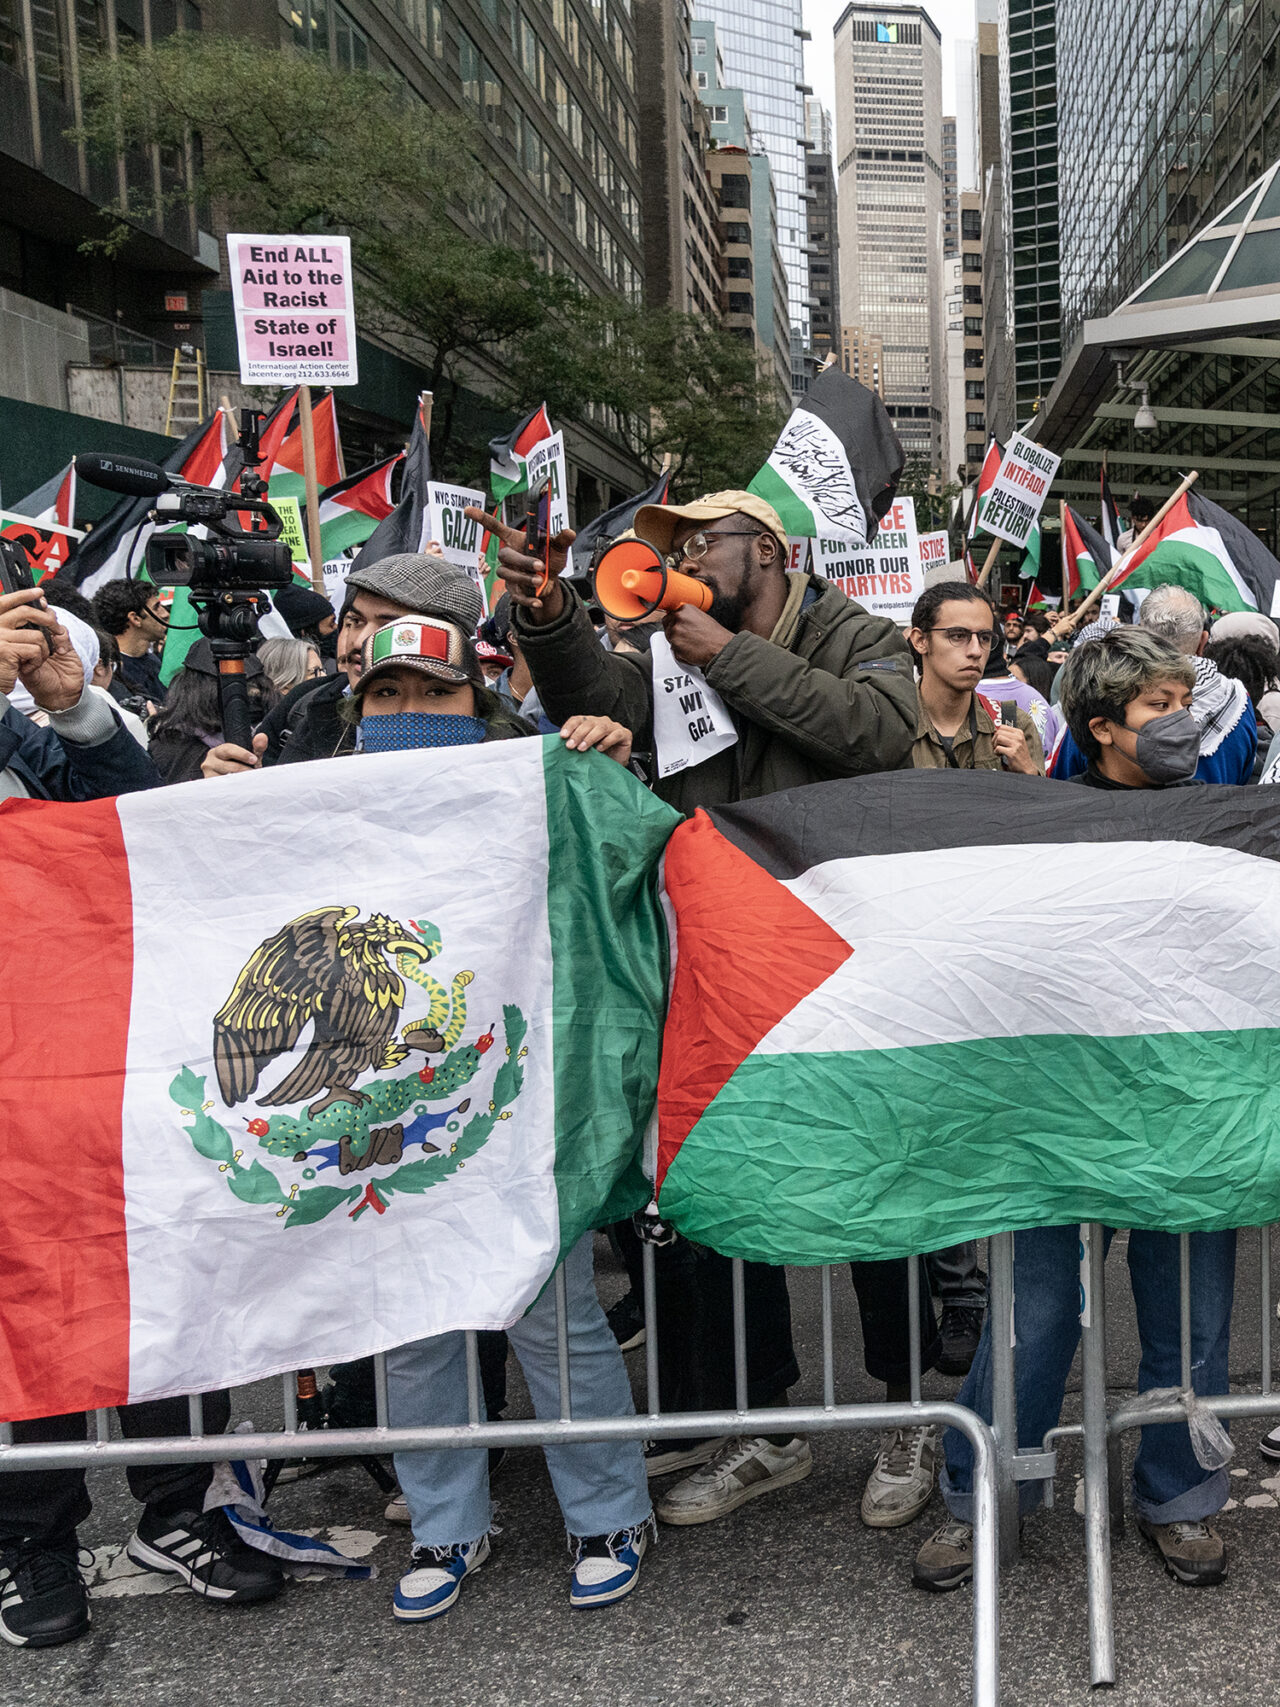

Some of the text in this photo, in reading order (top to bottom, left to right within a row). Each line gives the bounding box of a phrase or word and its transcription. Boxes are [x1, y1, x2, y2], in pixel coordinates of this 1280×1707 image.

[250, 247, 333, 263] End ALL
[243, 269, 343, 285] Aid to the
[263, 291, 328, 307] Racist
[254, 319, 337, 335] State of
[269, 341, 333, 357] Israel!
[248, 371, 297, 379] iacenter.org
[1013, 441, 1054, 475] GLOBALIZE
[115, 464, 158, 480] SENNHEISER
[1003, 461, 1046, 497] INTIFADA
[435, 490, 449, 506] NYC
[990, 487, 1036, 520] PALESTINIAN
[278, 506, 294, 515] THE
[283, 516, 295, 524] TO
[983, 500, 1031, 540] RETURN
[442, 507, 478, 553] GAZA
[825, 558, 876, 579] HONOR
[880, 557, 909, 573] OUR
